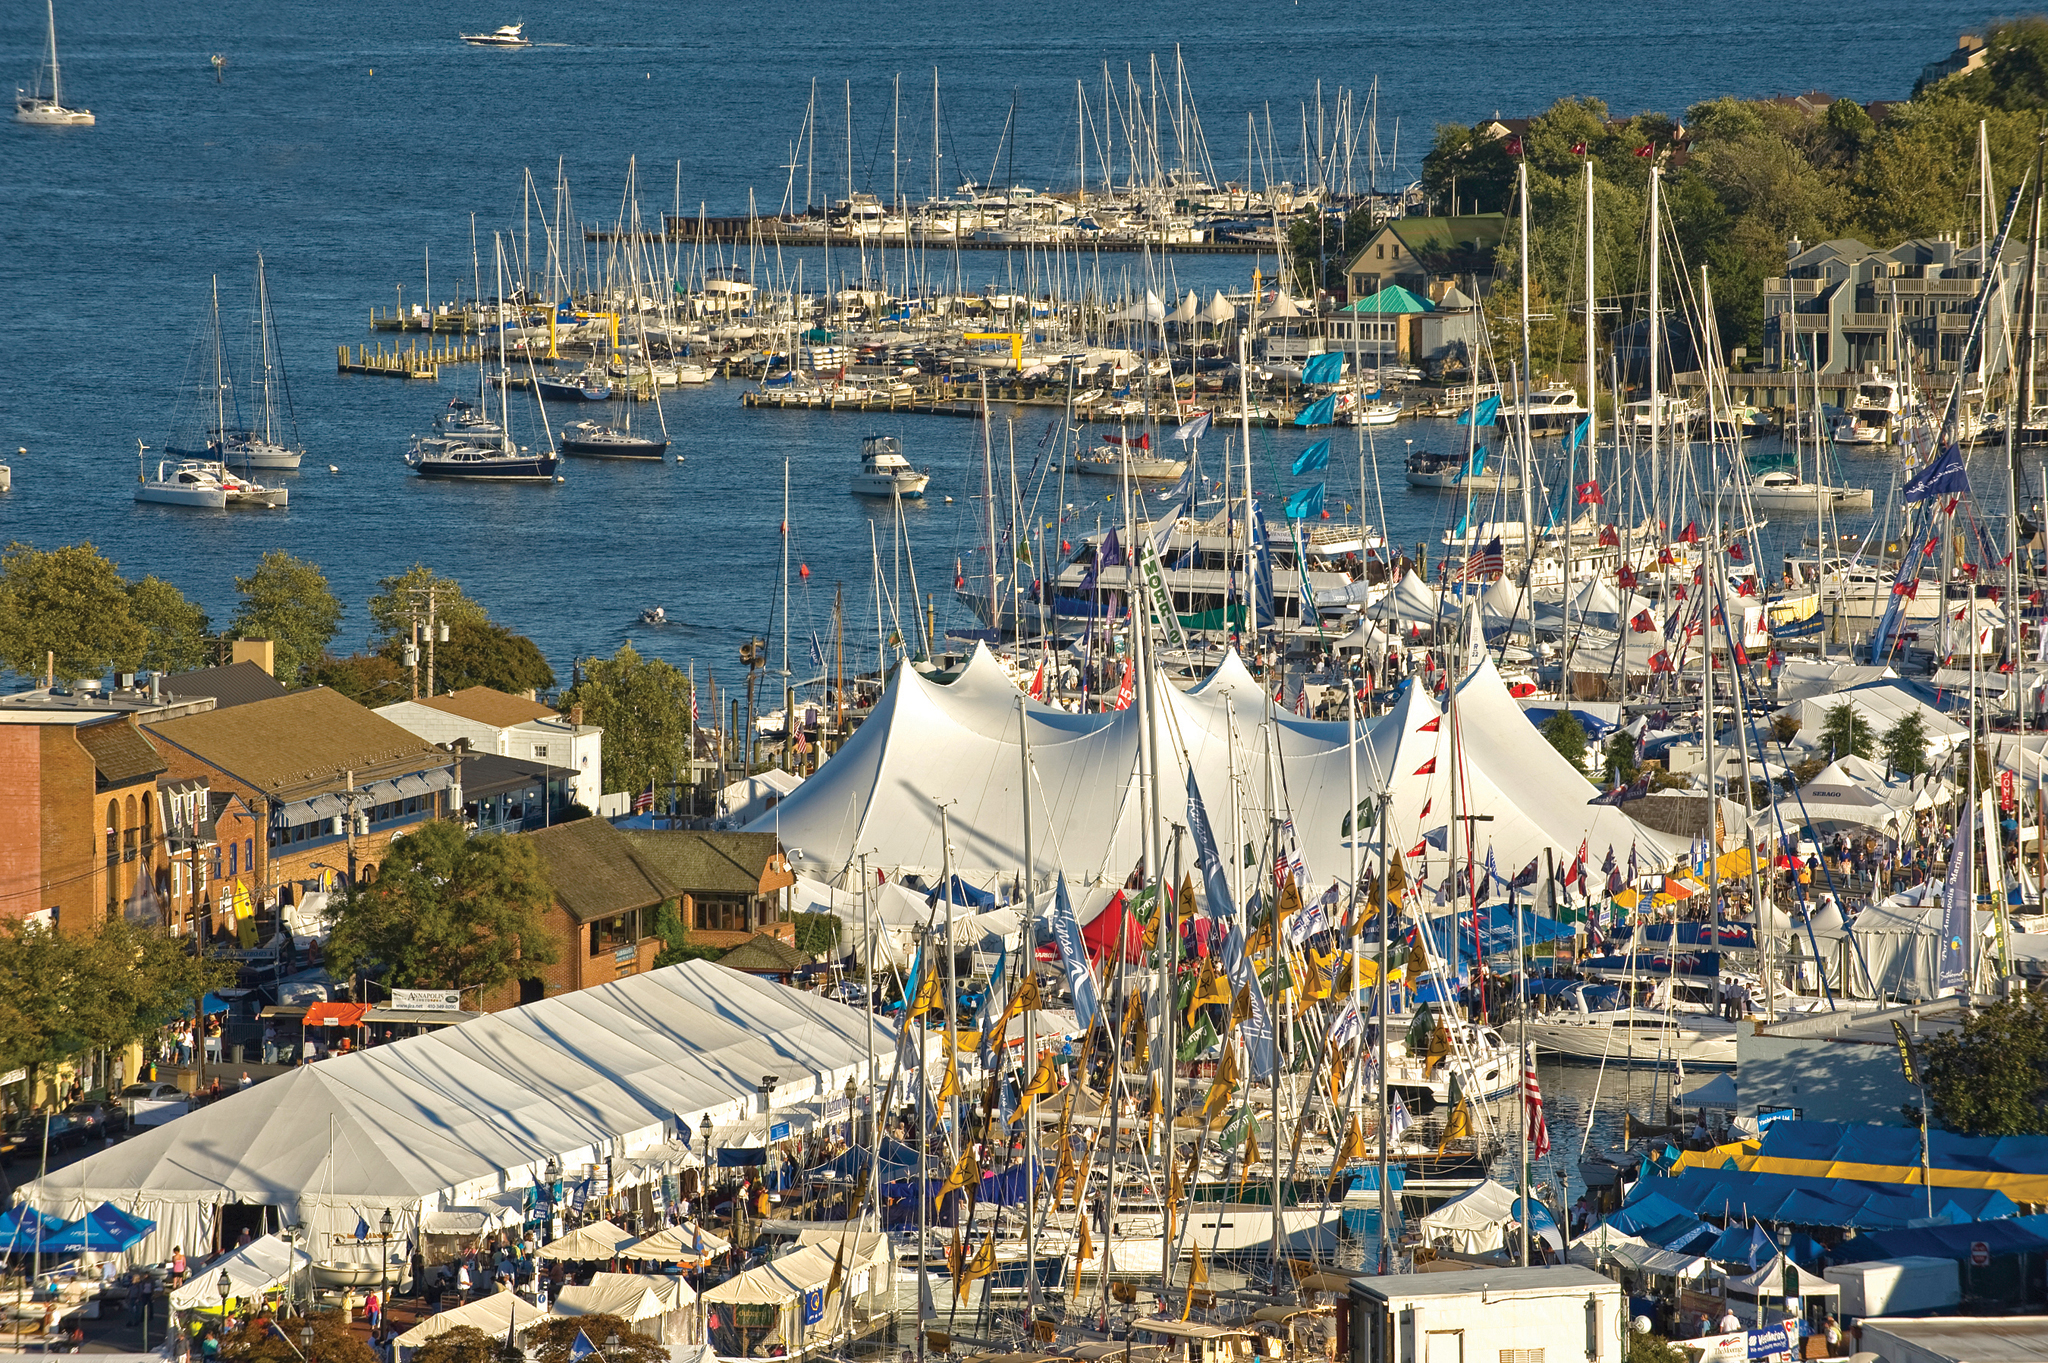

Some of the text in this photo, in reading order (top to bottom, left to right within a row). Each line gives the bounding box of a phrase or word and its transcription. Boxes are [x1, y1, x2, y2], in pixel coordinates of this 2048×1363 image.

[1943, 888, 1955, 938] Annapolis
[1949, 851, 1964, 885] Marina
[408, 992, 444, 1001] ANNAPOLIS
